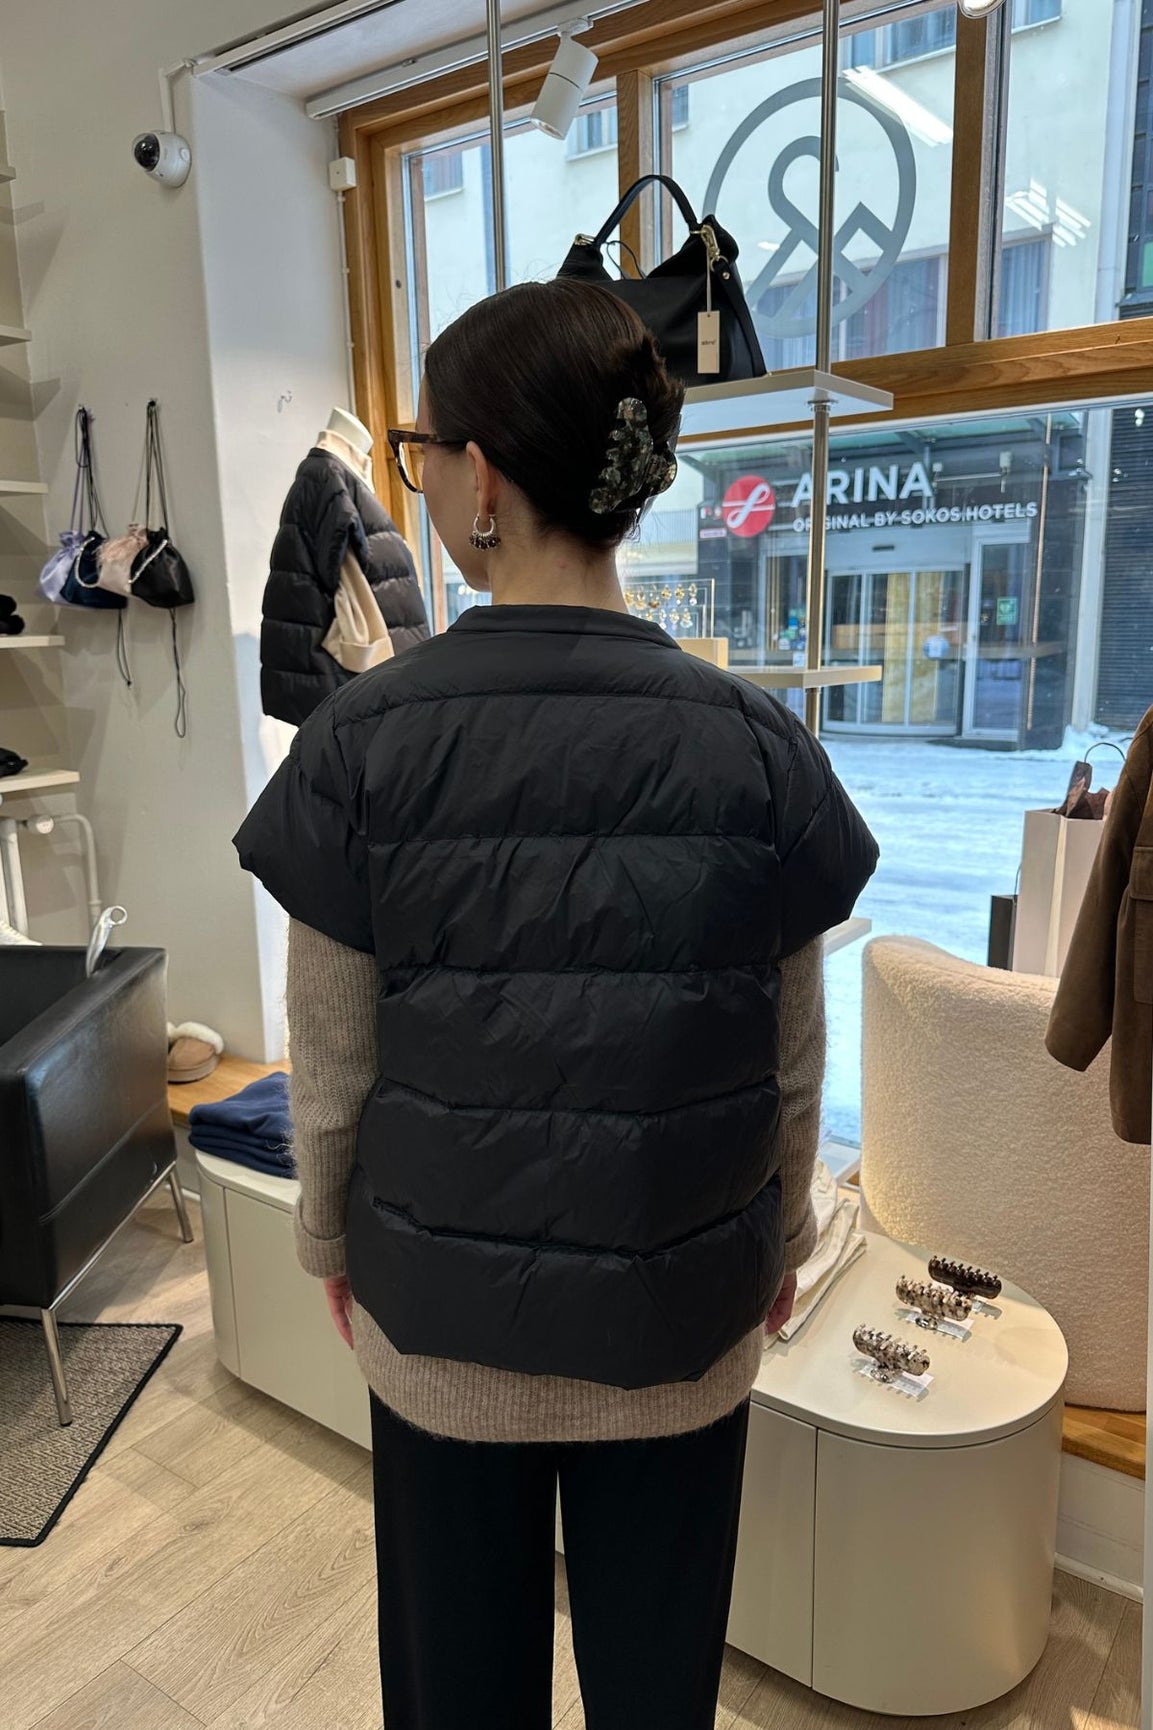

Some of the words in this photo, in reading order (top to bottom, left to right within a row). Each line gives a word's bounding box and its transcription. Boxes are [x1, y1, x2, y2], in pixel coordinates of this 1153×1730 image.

[791, 462, 933, 508] ARINA
[874, 511, 898, 527] BY
[901, 507, 961, 525] SOKOS
[966, 501, 1038, 520] HOTELS
